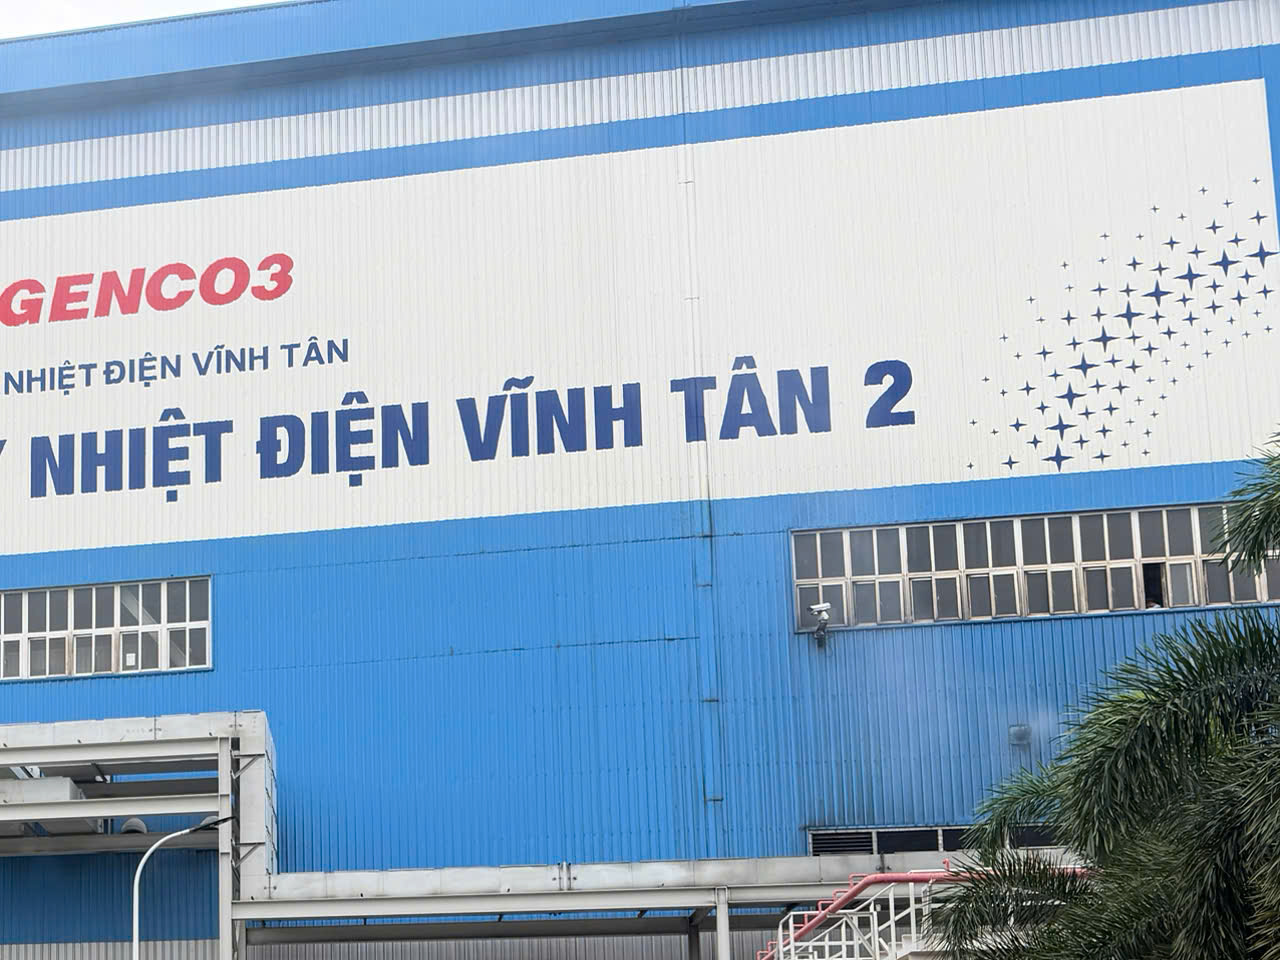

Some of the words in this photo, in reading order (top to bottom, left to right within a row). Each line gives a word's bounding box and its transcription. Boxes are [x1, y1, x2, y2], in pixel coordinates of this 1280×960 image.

[3, 360, 98, 396] NHIỆT
[102, 352, 182, 388] ĐIỆN
[191, 344, 270, 377] VĨNH
[279, 335, 350, 369] TÂN
[29, 407, 234, 503] NHIỆT
[255, 391, 430, 488] ĐIỆN
[455, 375, 644, 462] VĨNH
[670, 355, 832, 442] TÂN
[863, 359, 917, 430] 2
